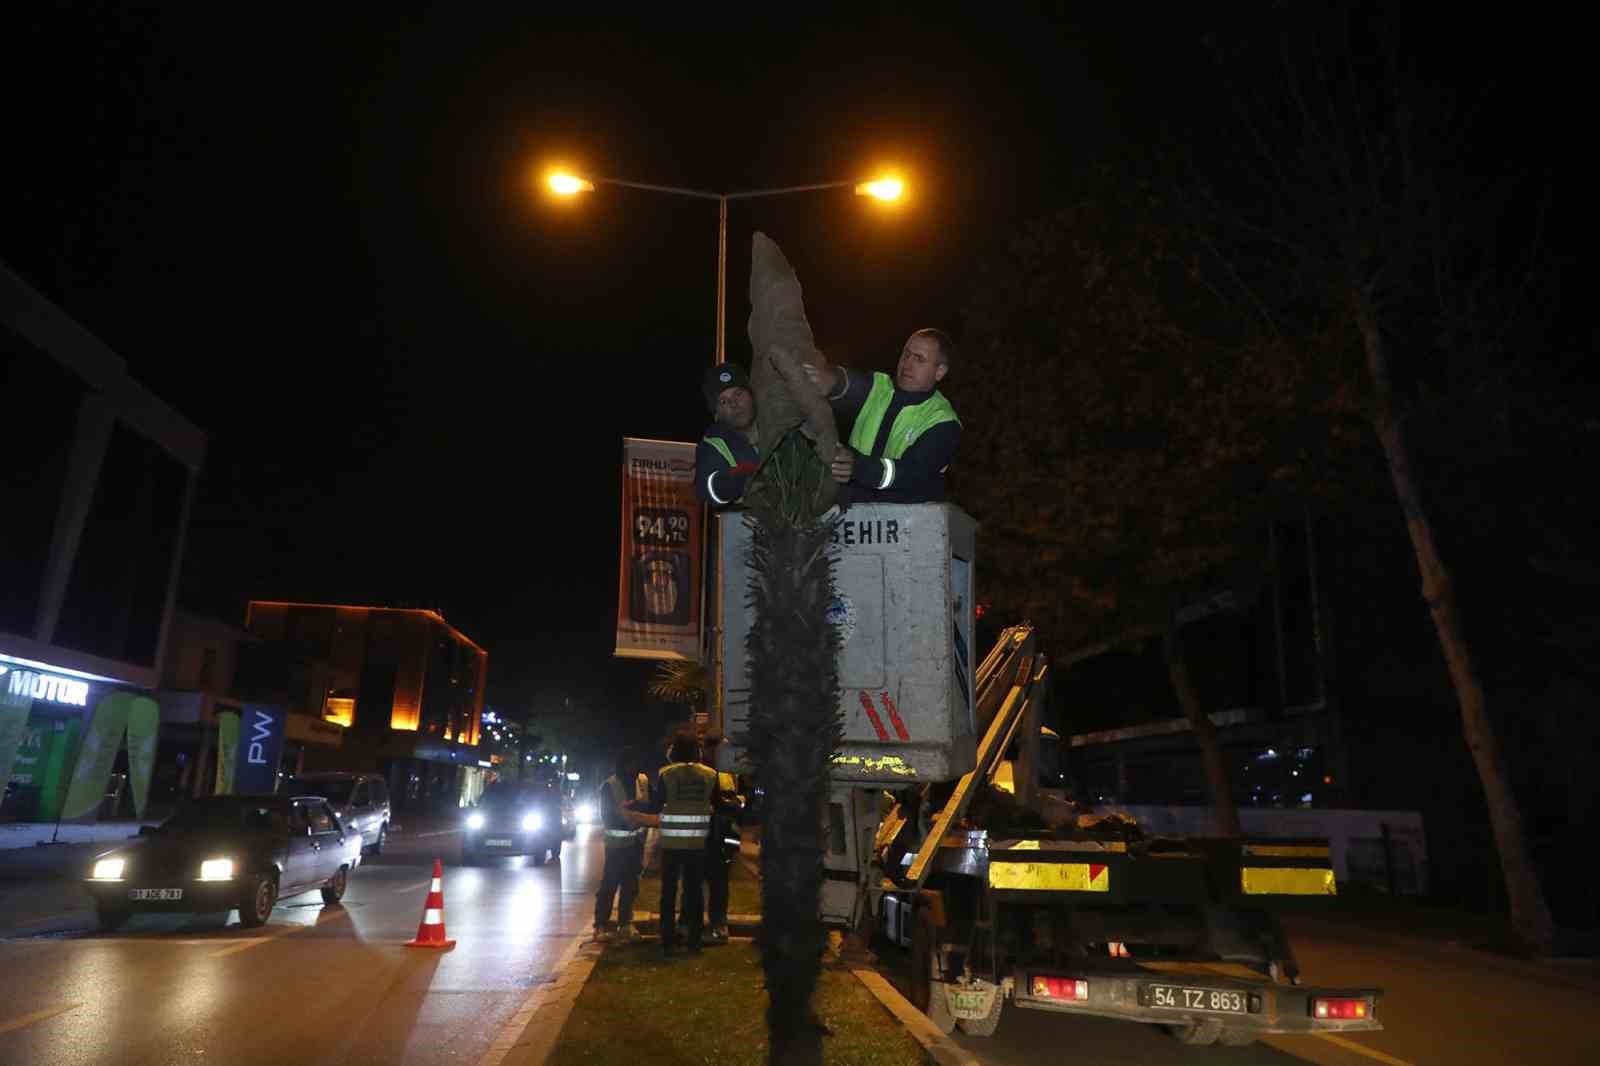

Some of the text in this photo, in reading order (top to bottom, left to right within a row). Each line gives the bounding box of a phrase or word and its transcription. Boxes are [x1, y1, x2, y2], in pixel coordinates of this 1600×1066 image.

[8, 669, 89, 706] MOTOR
[248, 711, 273, 764] PW
[1155, 987, 1240, 1010] 54 TZ 863
